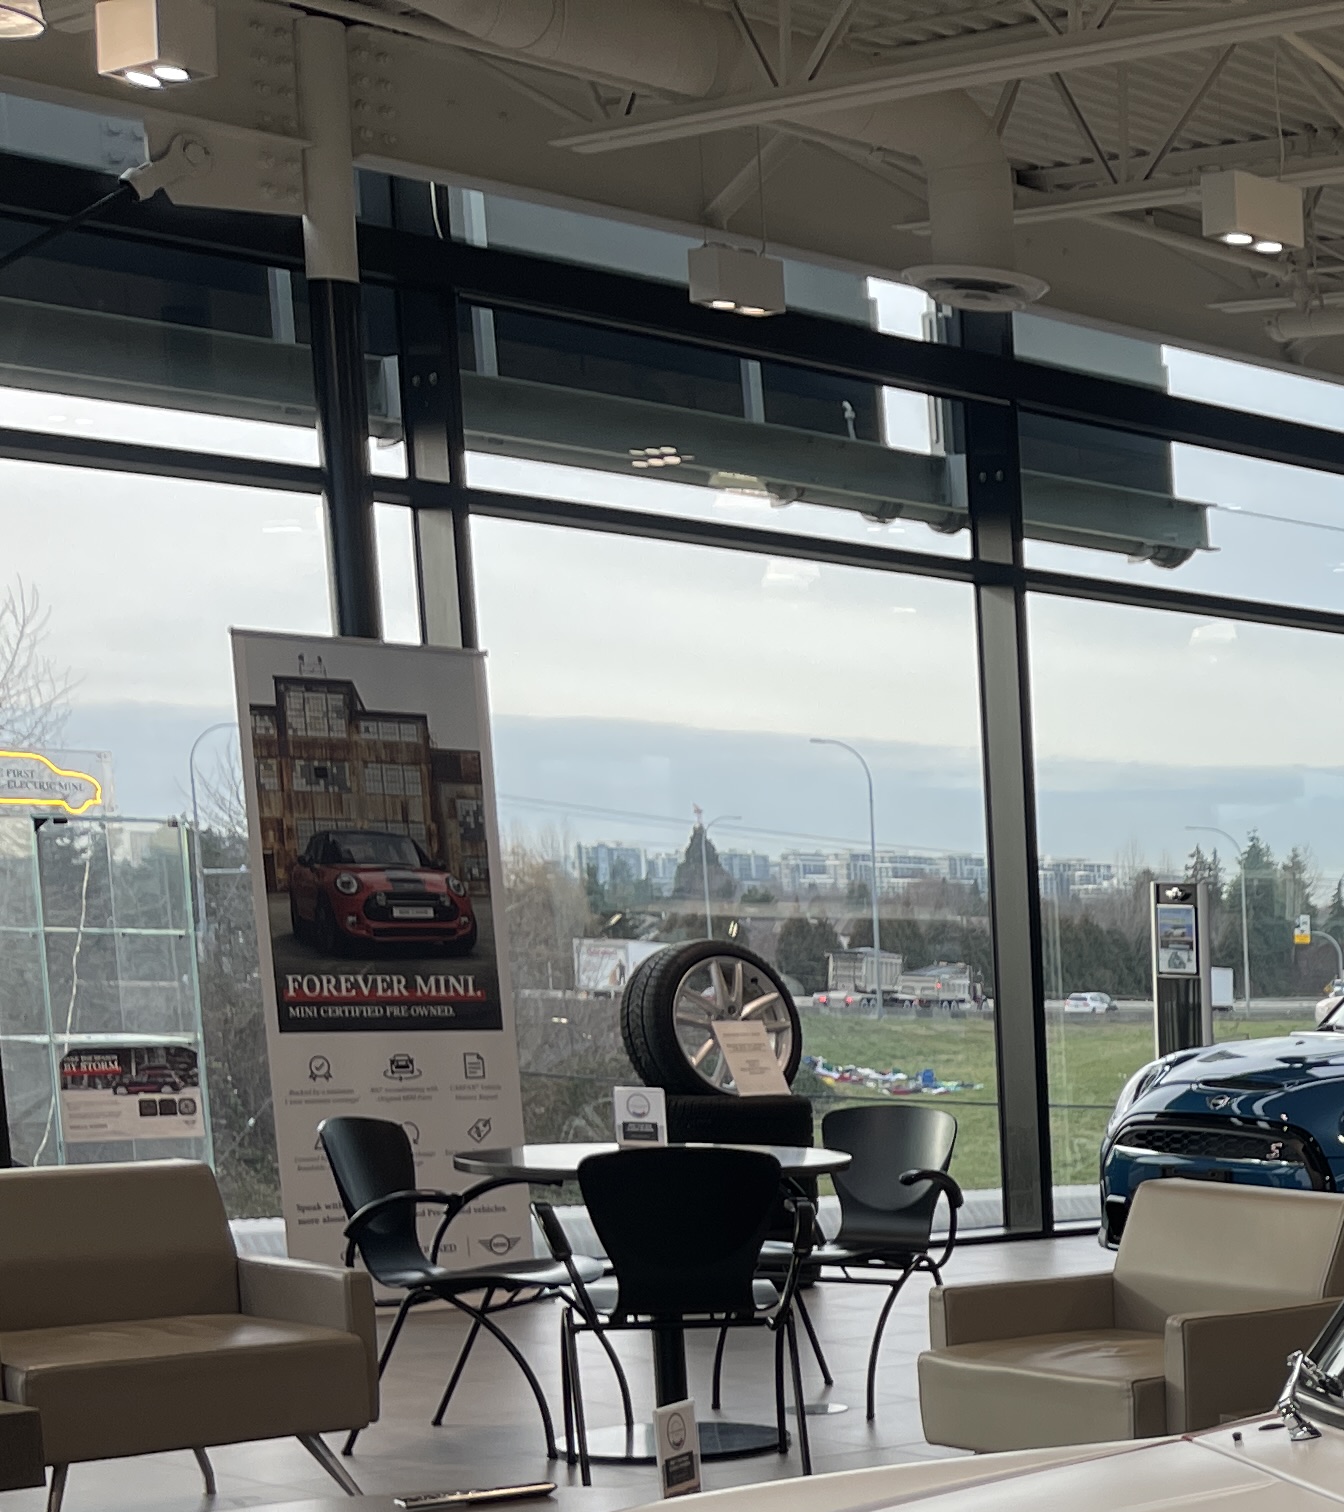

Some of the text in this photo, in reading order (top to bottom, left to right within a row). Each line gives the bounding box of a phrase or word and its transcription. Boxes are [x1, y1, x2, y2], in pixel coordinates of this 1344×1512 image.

[6, 768, 35, 778] FIRST
[286, 974, 482, 998] FOREVER MINI.
[288, 1005, 318, 1018] MINI
[320, 1005, 384, 1018] CERTIFIED
